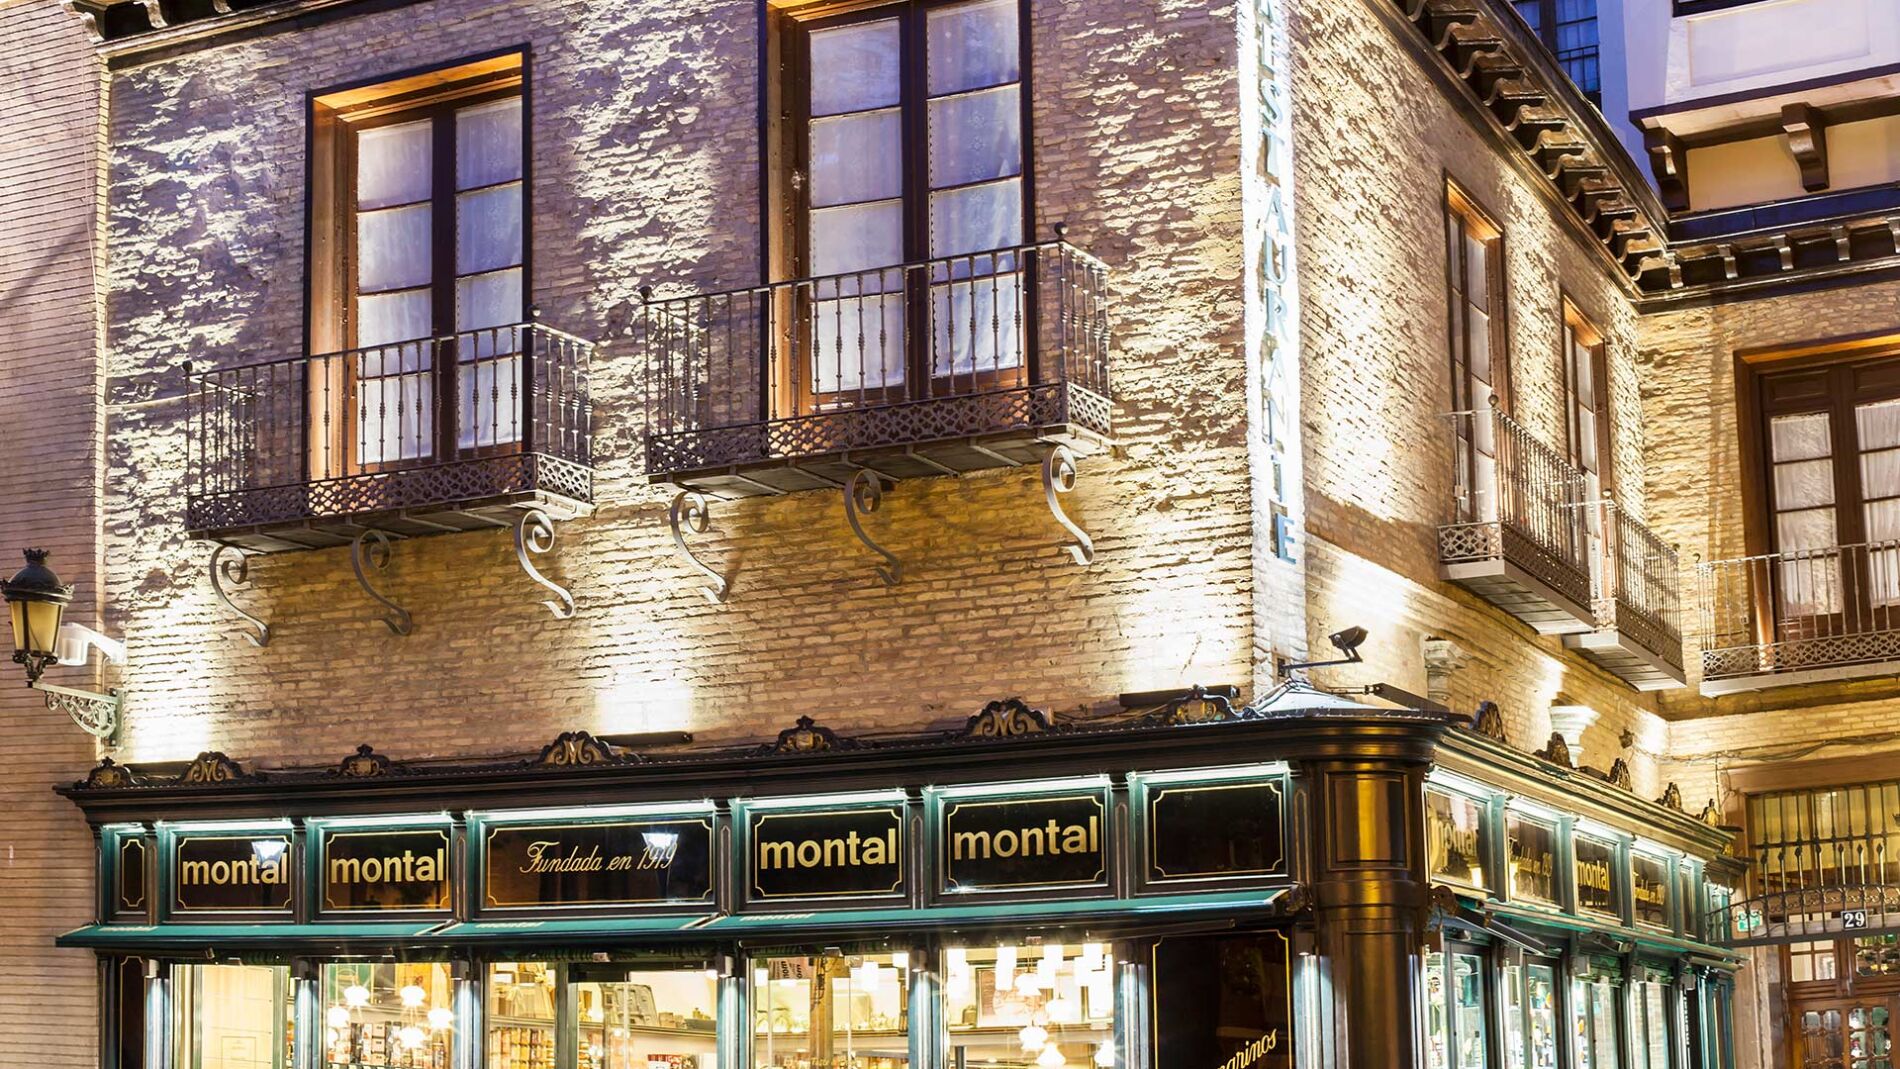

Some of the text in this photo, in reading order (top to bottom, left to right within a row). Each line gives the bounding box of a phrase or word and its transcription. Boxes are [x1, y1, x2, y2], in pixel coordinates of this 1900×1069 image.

[760, 828, 896, 869] montal
[954, 815, 1098, 860] montal
[182, 852, 287, 885] montal
[330, 848, 444, 883] montal
[519, 841, 678, 873] Fundada en 1919
[1576, 859, 1610, 892] montal
[1844, 912, 1865, 928] 29
[1217, 1028, 1277, 1069] arinos
